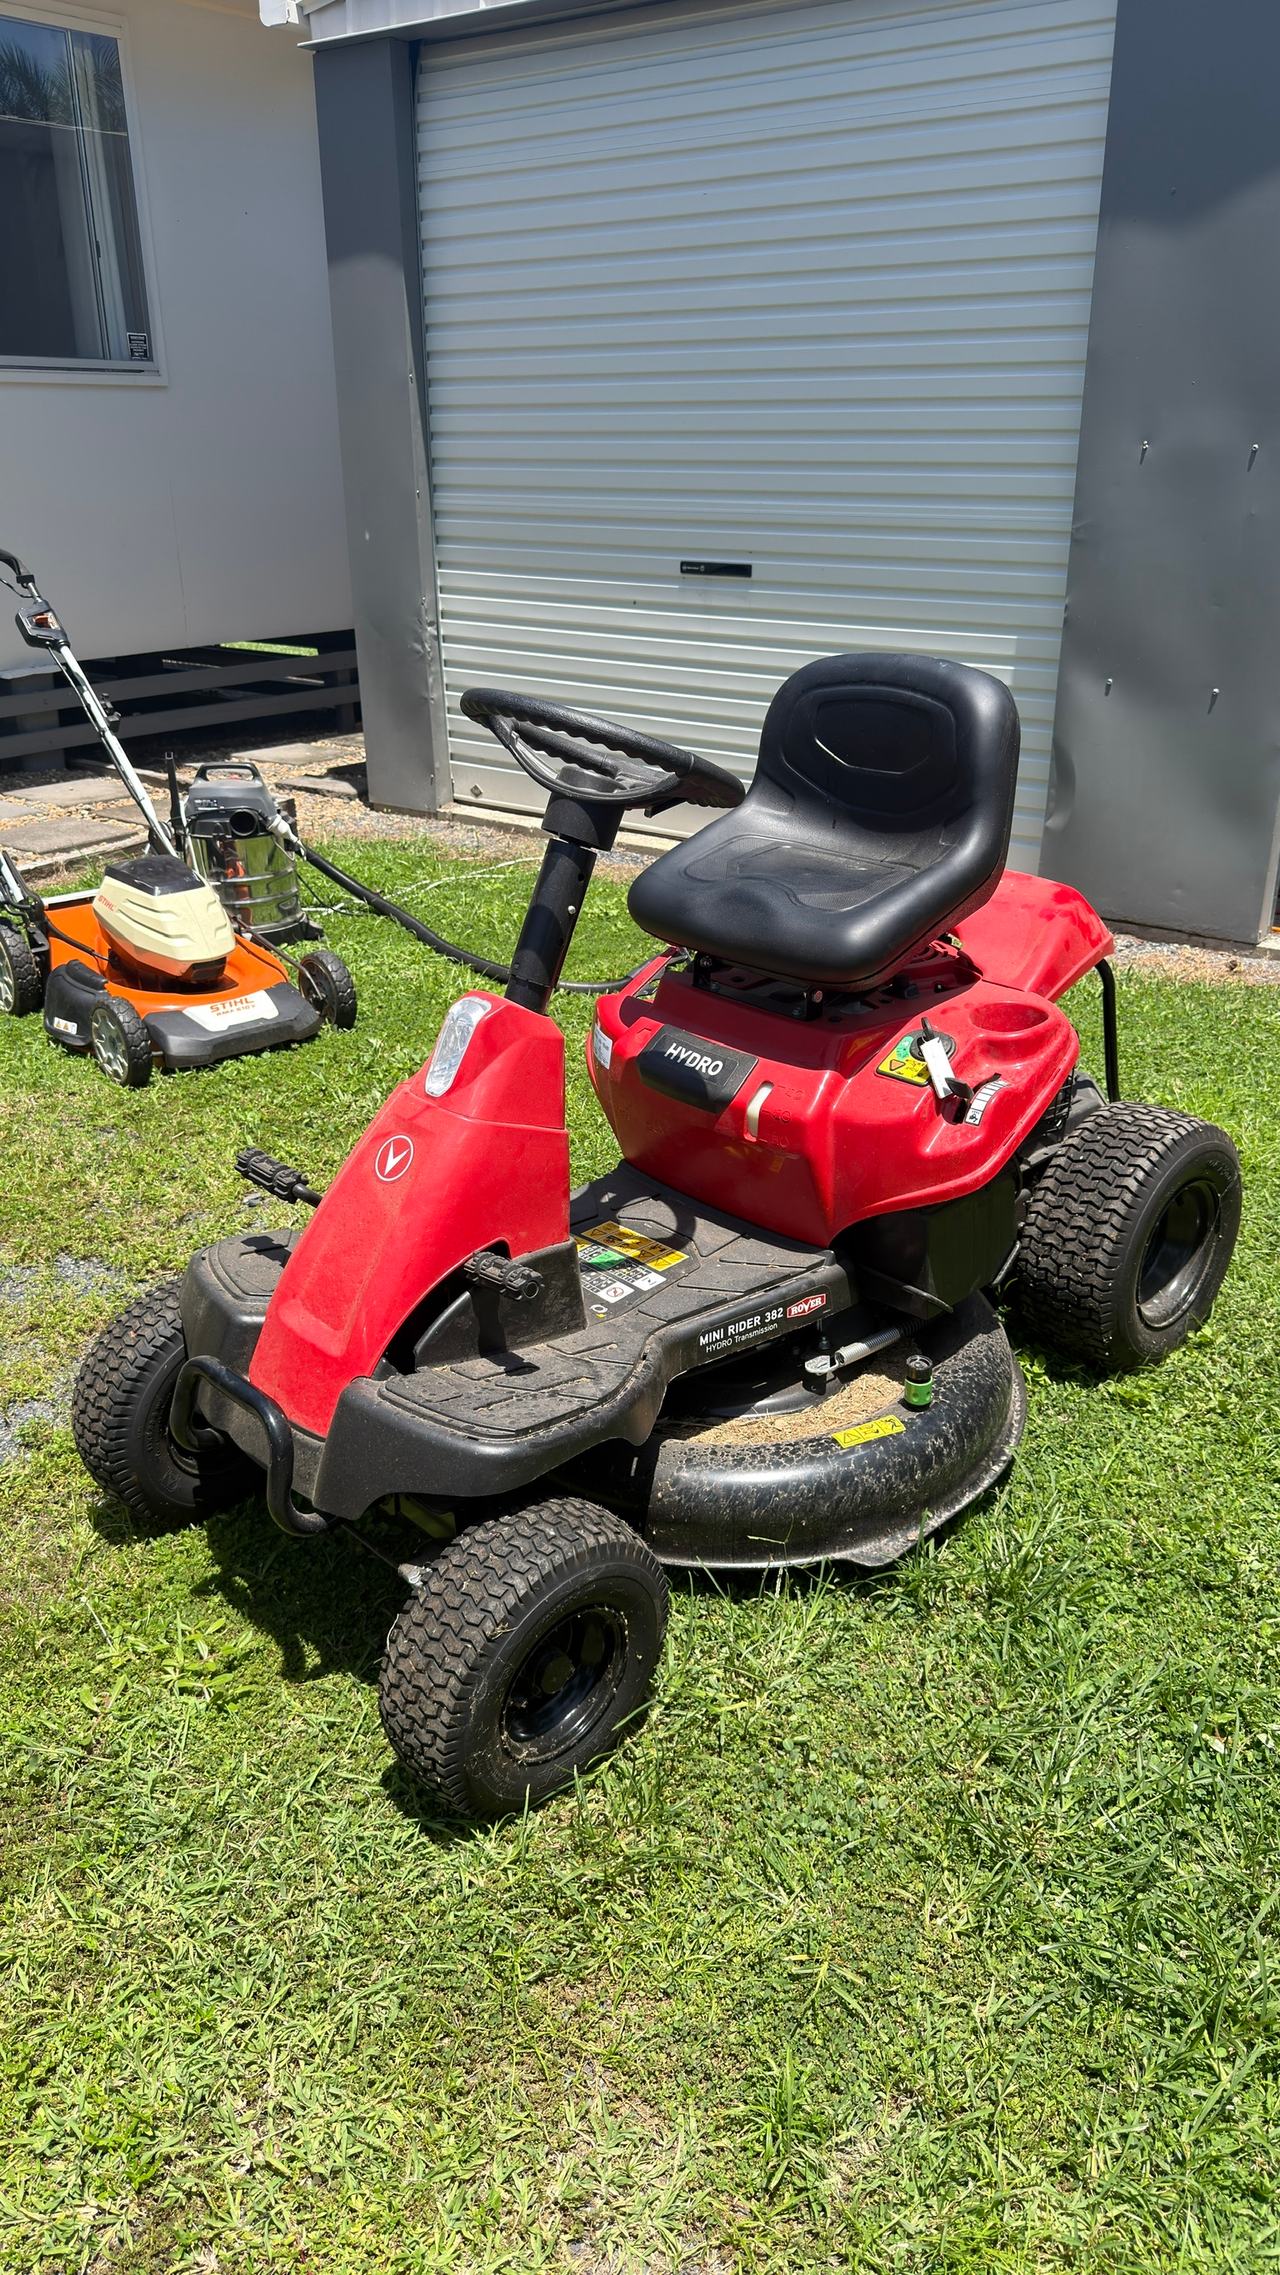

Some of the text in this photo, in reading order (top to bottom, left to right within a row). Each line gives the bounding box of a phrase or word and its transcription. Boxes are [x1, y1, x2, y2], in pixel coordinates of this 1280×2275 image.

[98, 895, 114, 911] STIHL
[209, 997, 255, 1013] STIHL
[664, 1042, 724, 1076] HYDRO
[790, 1297, 822, 1316] ROVER
[699, 1307, 784, 1346] MINI RIDER 382
[705, 1322, 778, 1353] HYDRO Transmission
